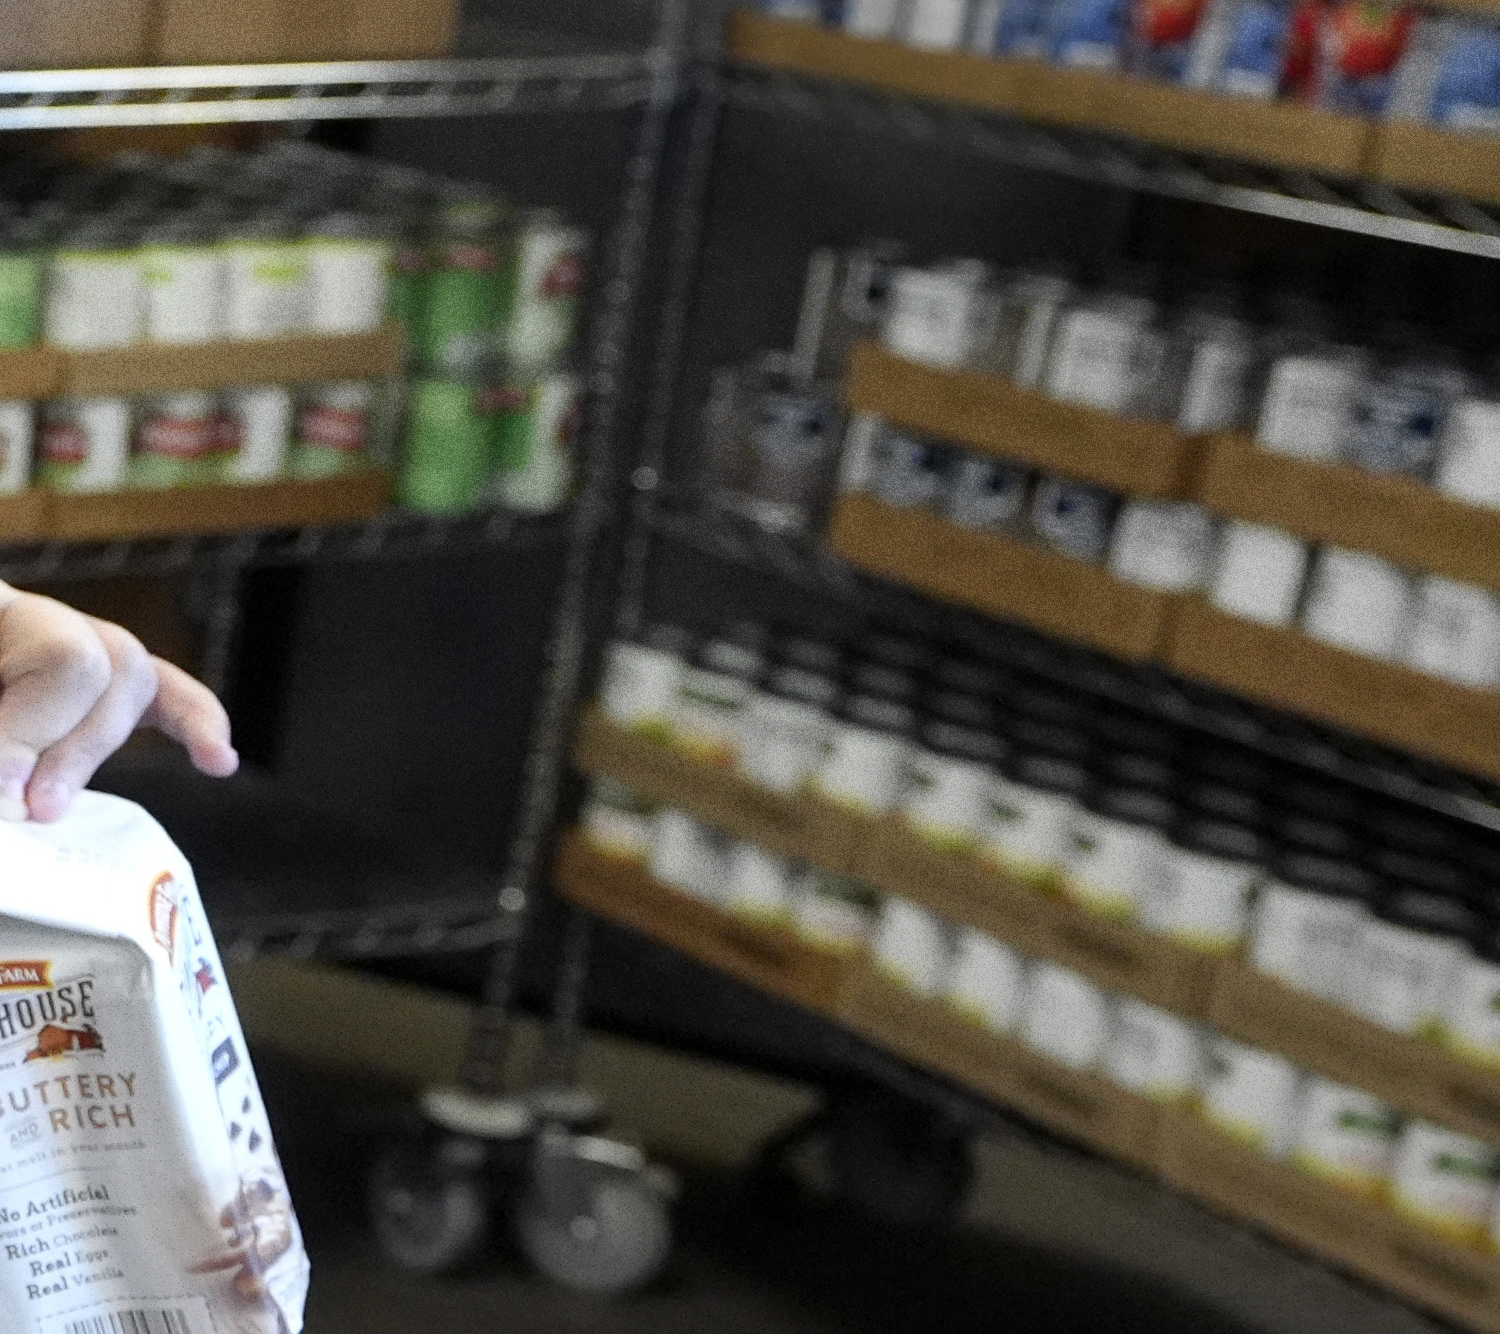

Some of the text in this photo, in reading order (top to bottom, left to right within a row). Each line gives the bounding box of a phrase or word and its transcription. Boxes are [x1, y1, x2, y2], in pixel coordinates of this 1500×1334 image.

[49, 1103, 137, 1134] RICH
[26, 1183, 111, 1218] Artificial
[5, 1237, 50, 1261] Rich
[29, 1251, 71, 1278] Real
[26, 1267, 126, 1301] Real Vanilla
